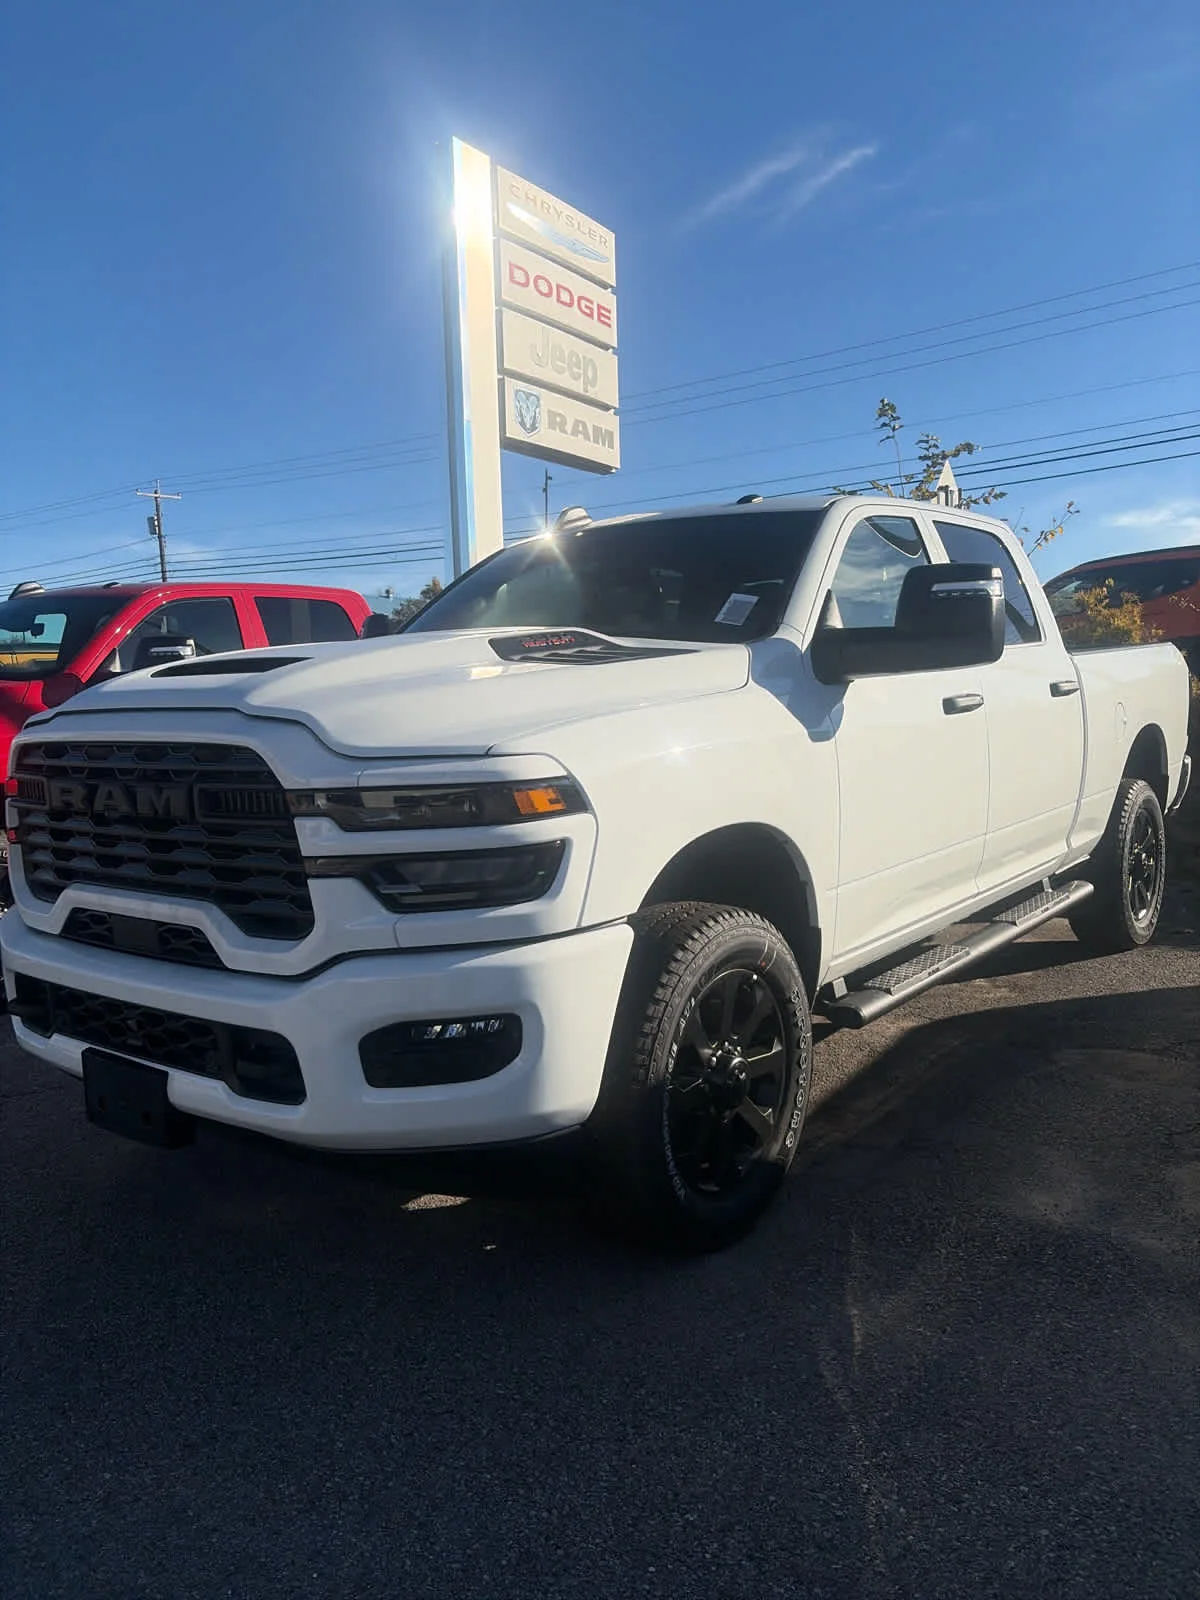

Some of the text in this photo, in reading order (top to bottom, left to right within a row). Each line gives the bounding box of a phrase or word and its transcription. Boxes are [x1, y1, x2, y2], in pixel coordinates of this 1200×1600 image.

[509, 183, 609, 249] CHRYSLER
[508, 261, 612, 328] DODGE
[530, 326, 599, 393] Jeep
[546, 409, 615, 450] RAM
[51, 781, 187, 818] RAM
